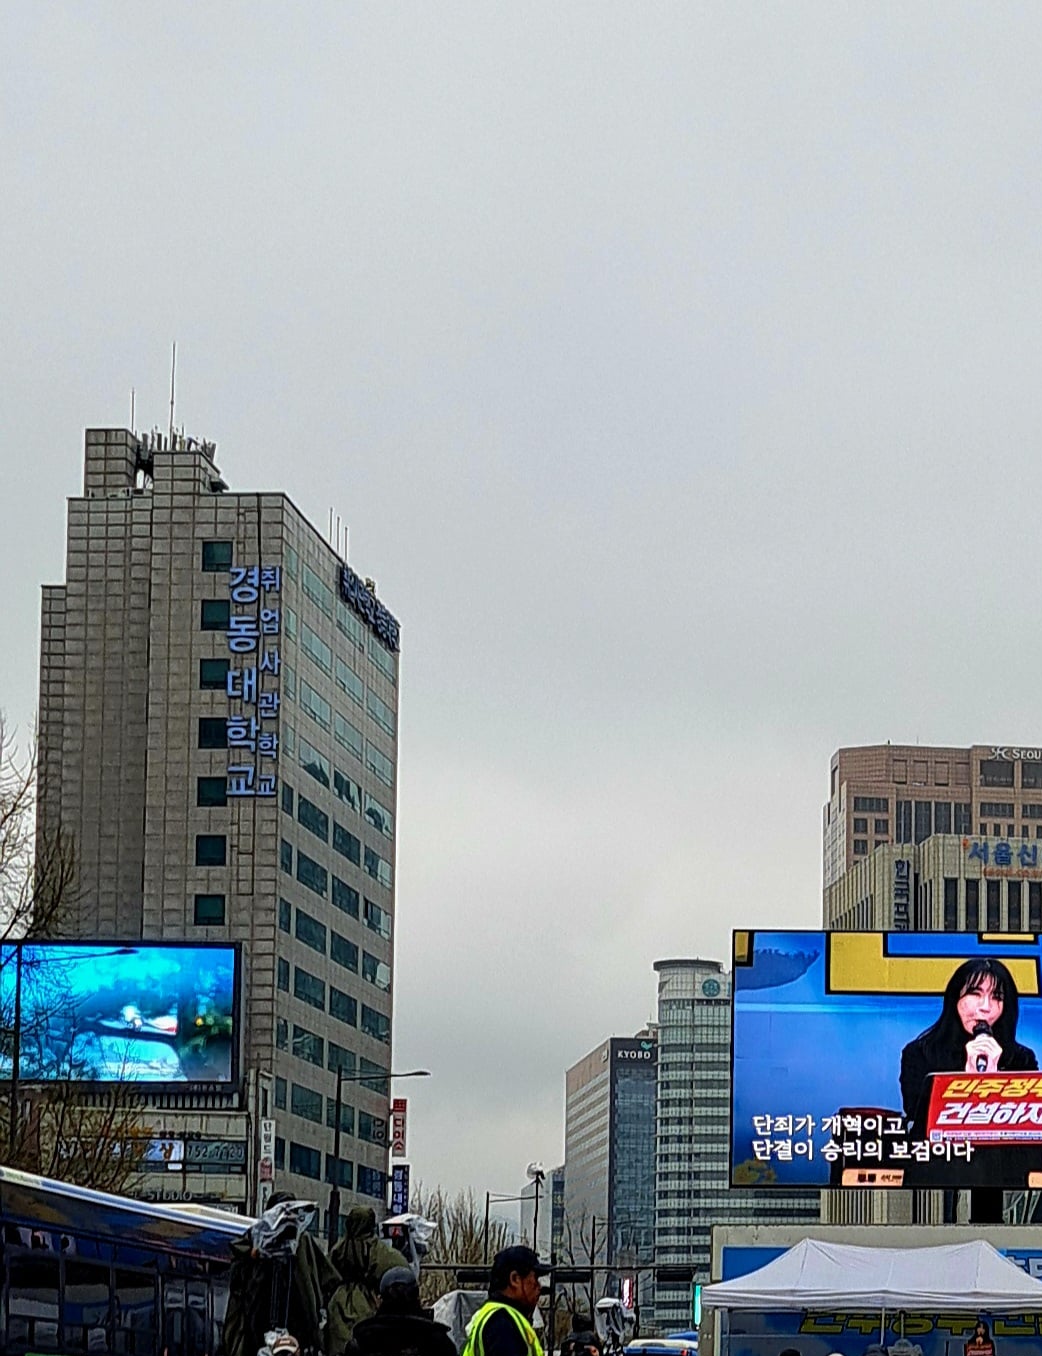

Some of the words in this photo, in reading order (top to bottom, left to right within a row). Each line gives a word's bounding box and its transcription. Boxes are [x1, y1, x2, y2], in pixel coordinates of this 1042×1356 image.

[226, 566, 260, 796] 경동대학교
[256, 566, 281, 795] 취업사관학교
[617, 1050, 651, 1060] KYOBO
[751, 1114, 816, 1136] 단죄가
[821, 1115, 906, 1137] 개혁이고
[751, 1139, 814, 1162] 단결이
[820, 1139, 883, 1162] 승리의
[888, 1139, 975, 1163] 보검이다
